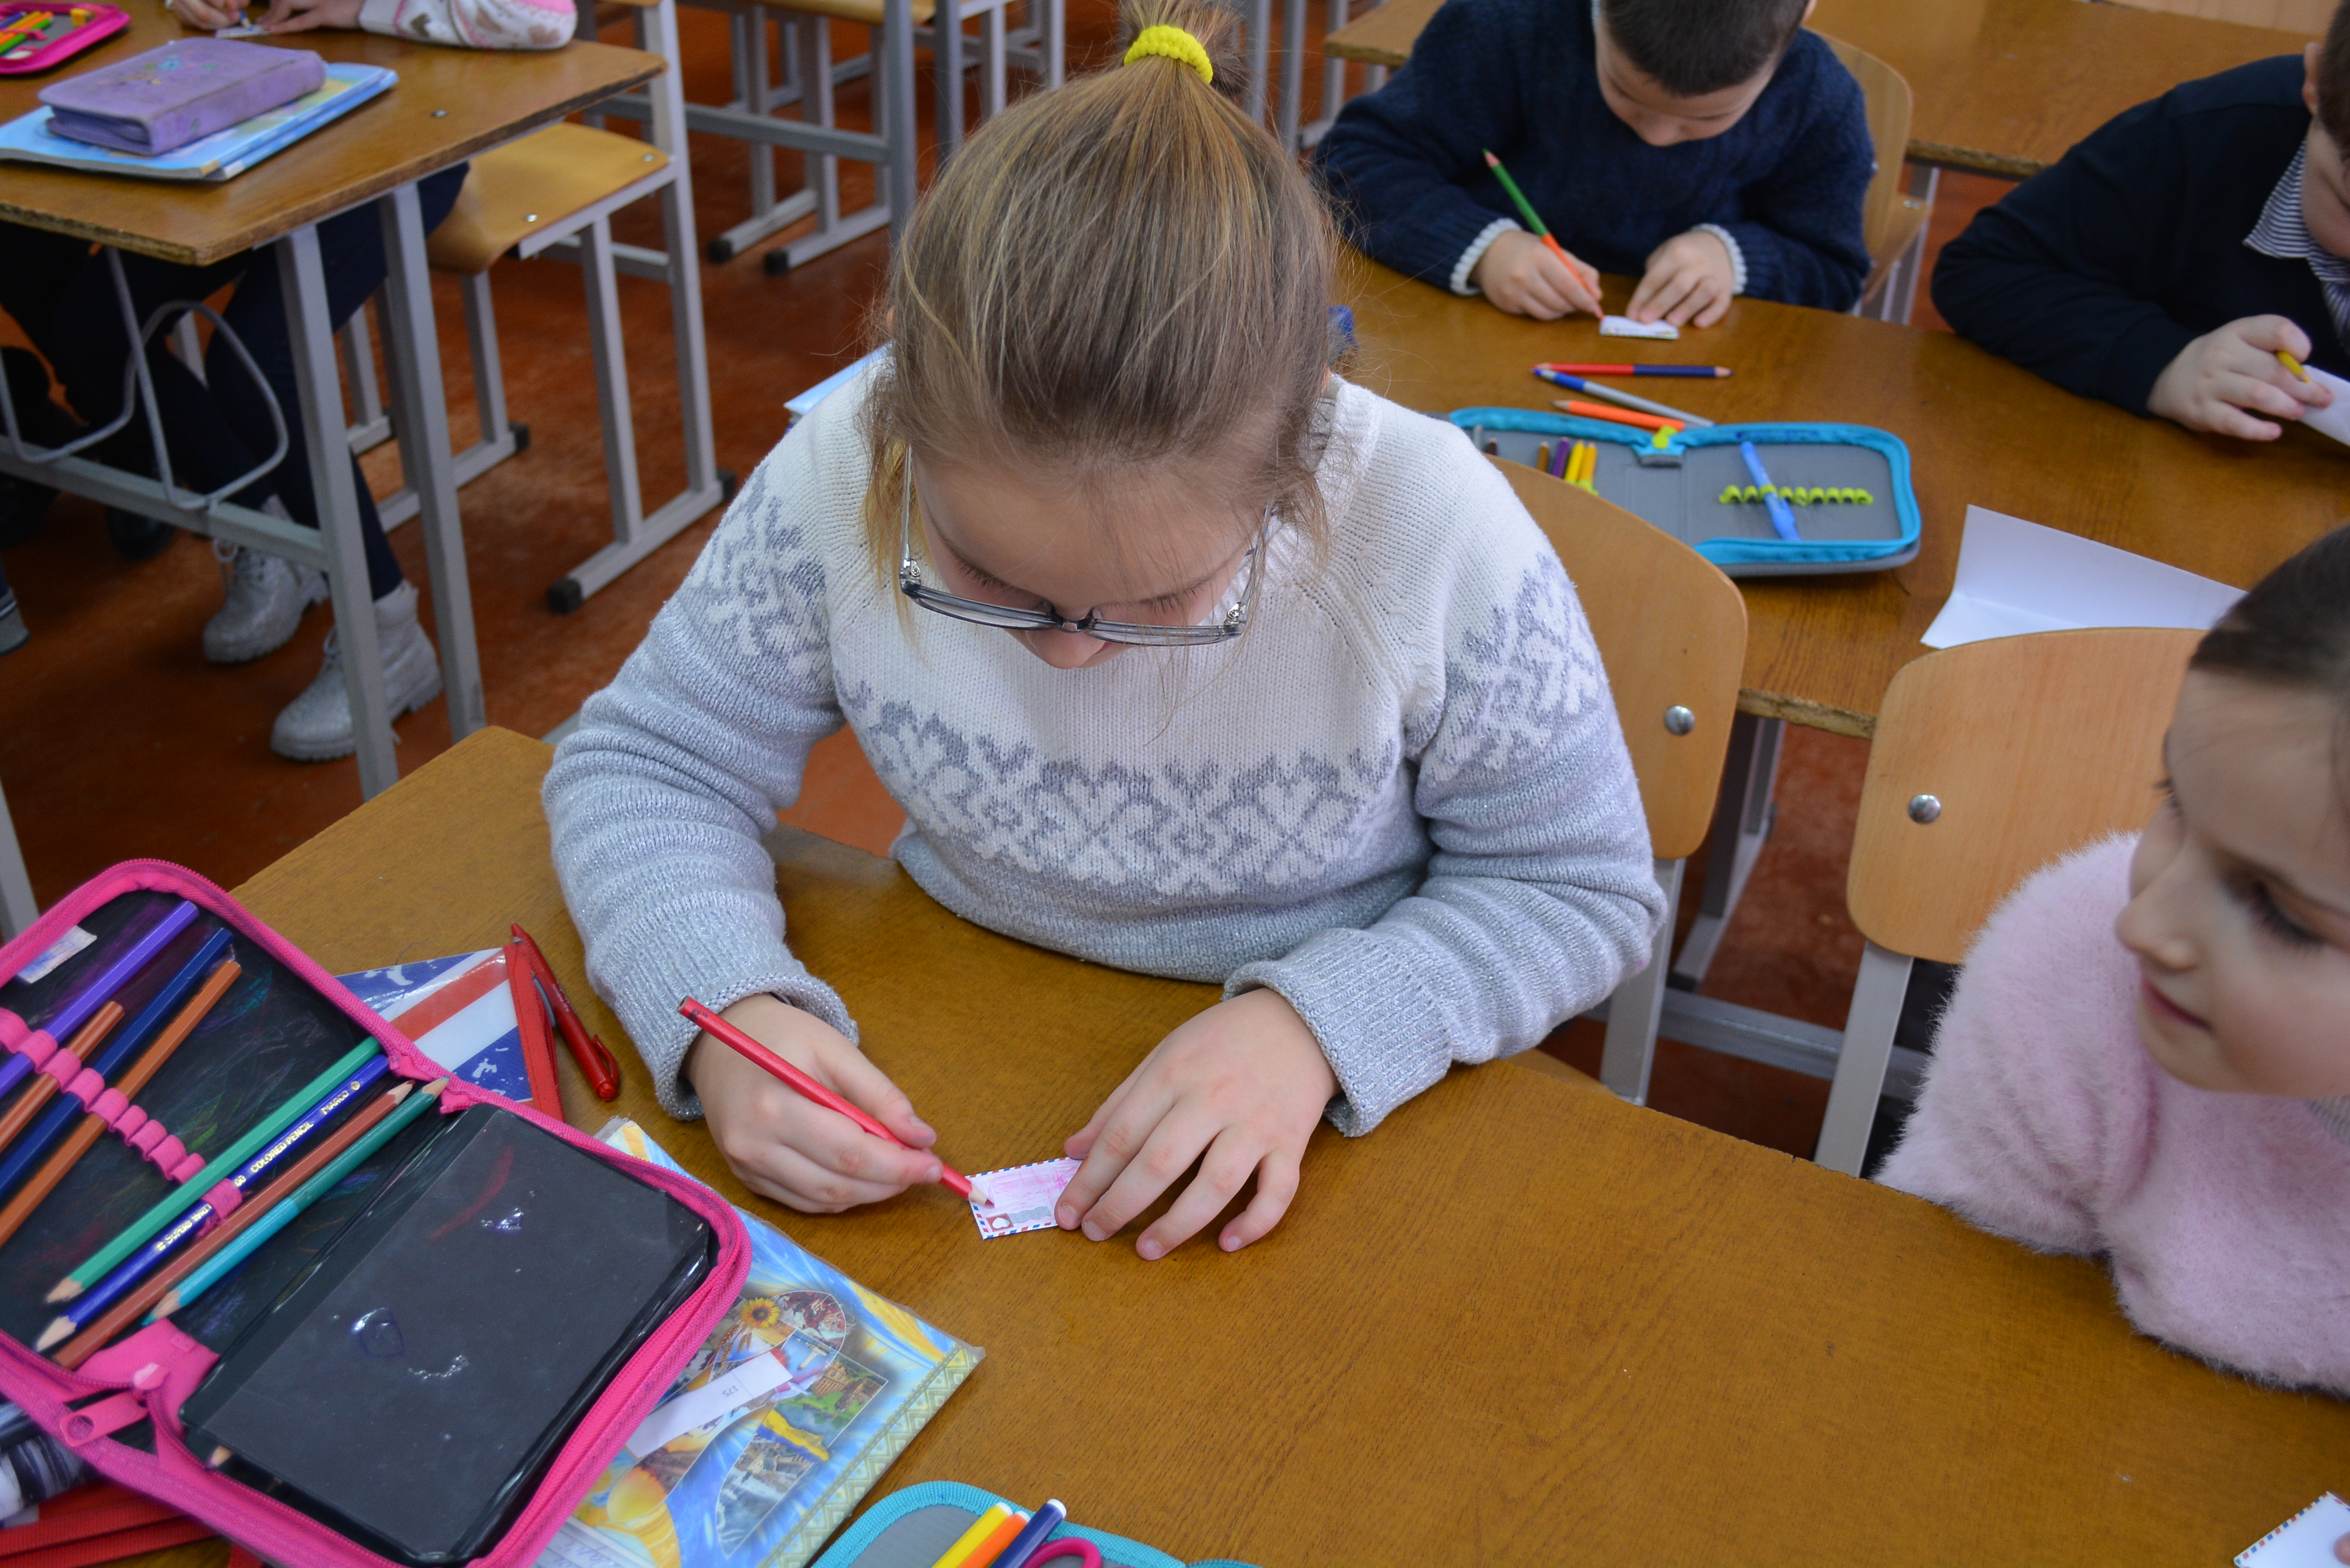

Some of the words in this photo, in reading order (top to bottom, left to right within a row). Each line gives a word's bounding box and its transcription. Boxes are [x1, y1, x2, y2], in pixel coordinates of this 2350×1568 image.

[250, 1139, 288, 1174] COLORED
[284, 1121, 315, 1145] PENCIL
[321, 1090, 350, 1116] MARCO
[722, 1385, 739, 1397] 175
